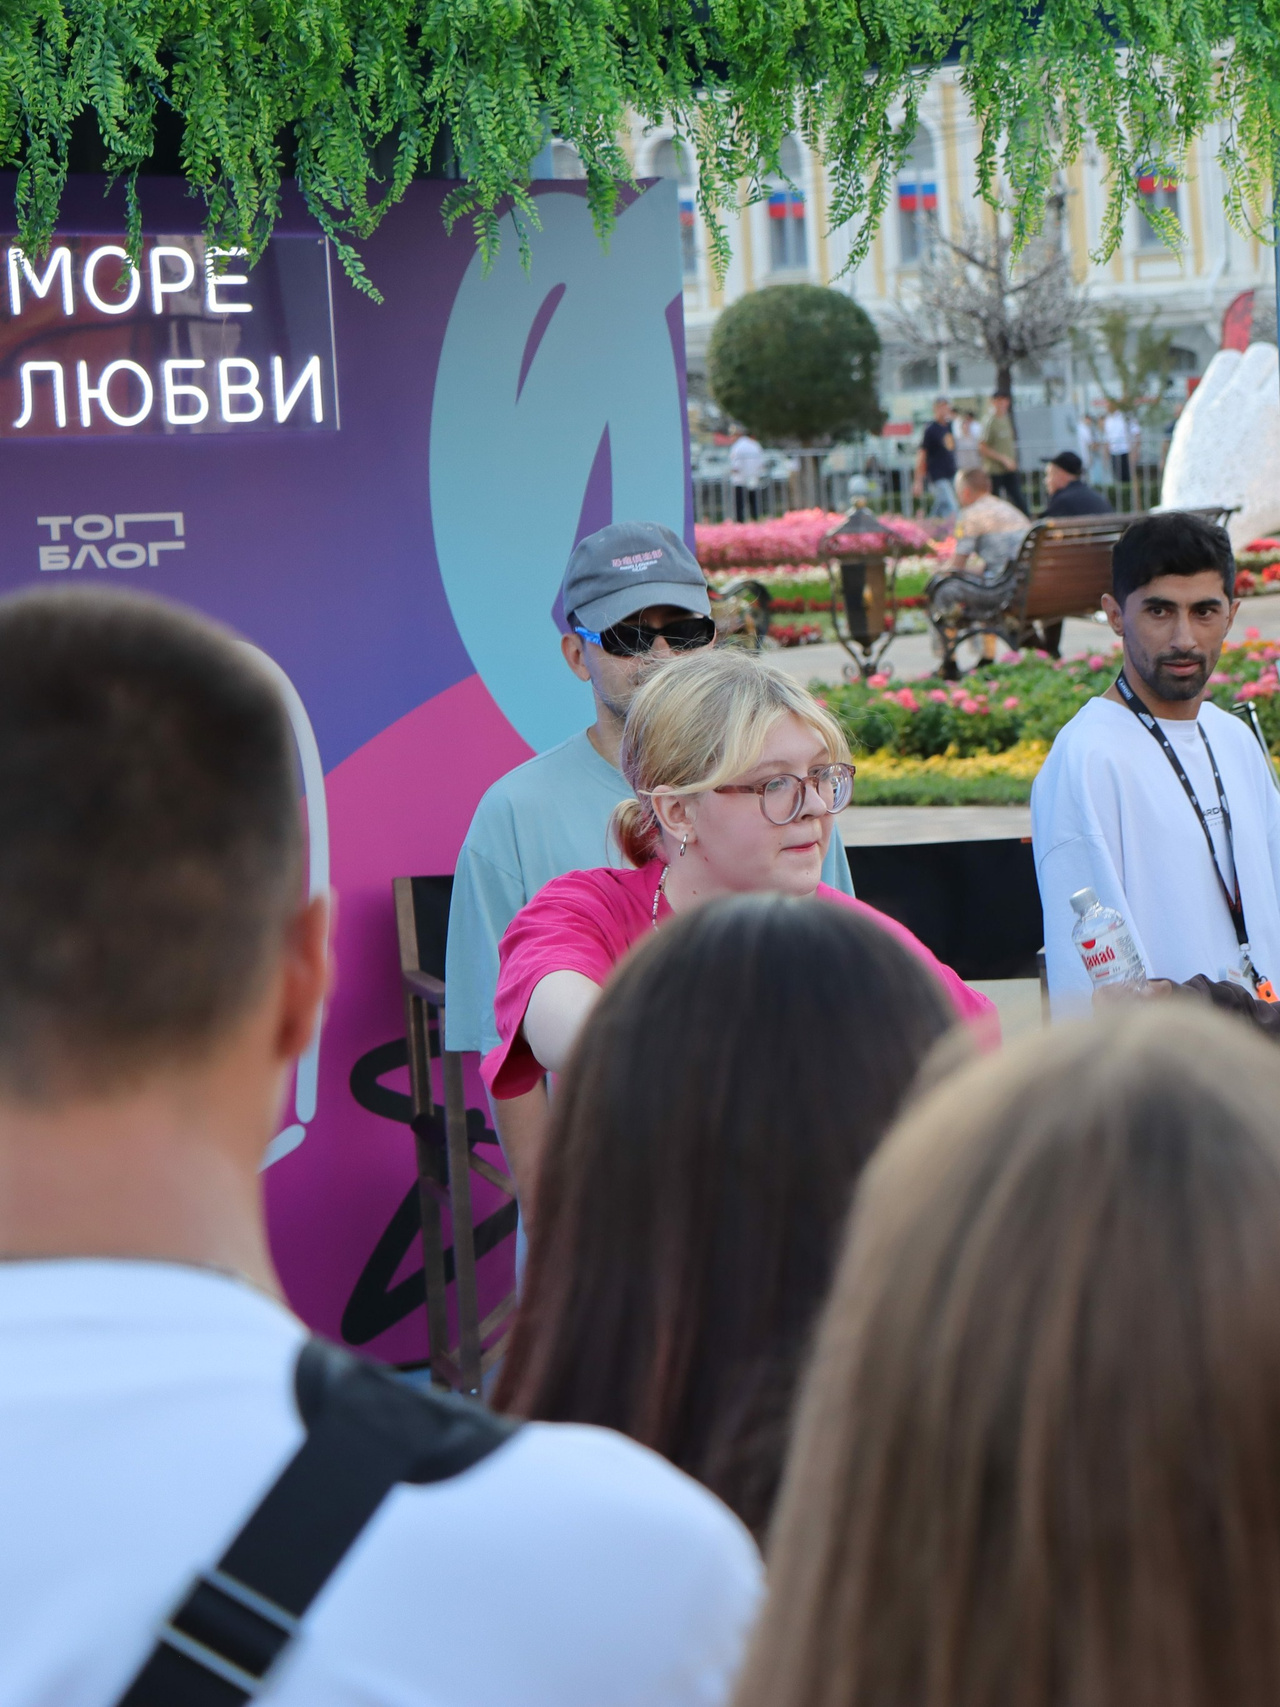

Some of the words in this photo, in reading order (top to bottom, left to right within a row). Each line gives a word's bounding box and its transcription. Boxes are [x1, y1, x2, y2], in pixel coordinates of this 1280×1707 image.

[8, 245, 253, 316] МОРЕ
[13, 355, 323, 429] ЛЮБВИ
[37, 512, 185, 541] ТОП
[39, 541, 185, 571] БЛОГ
